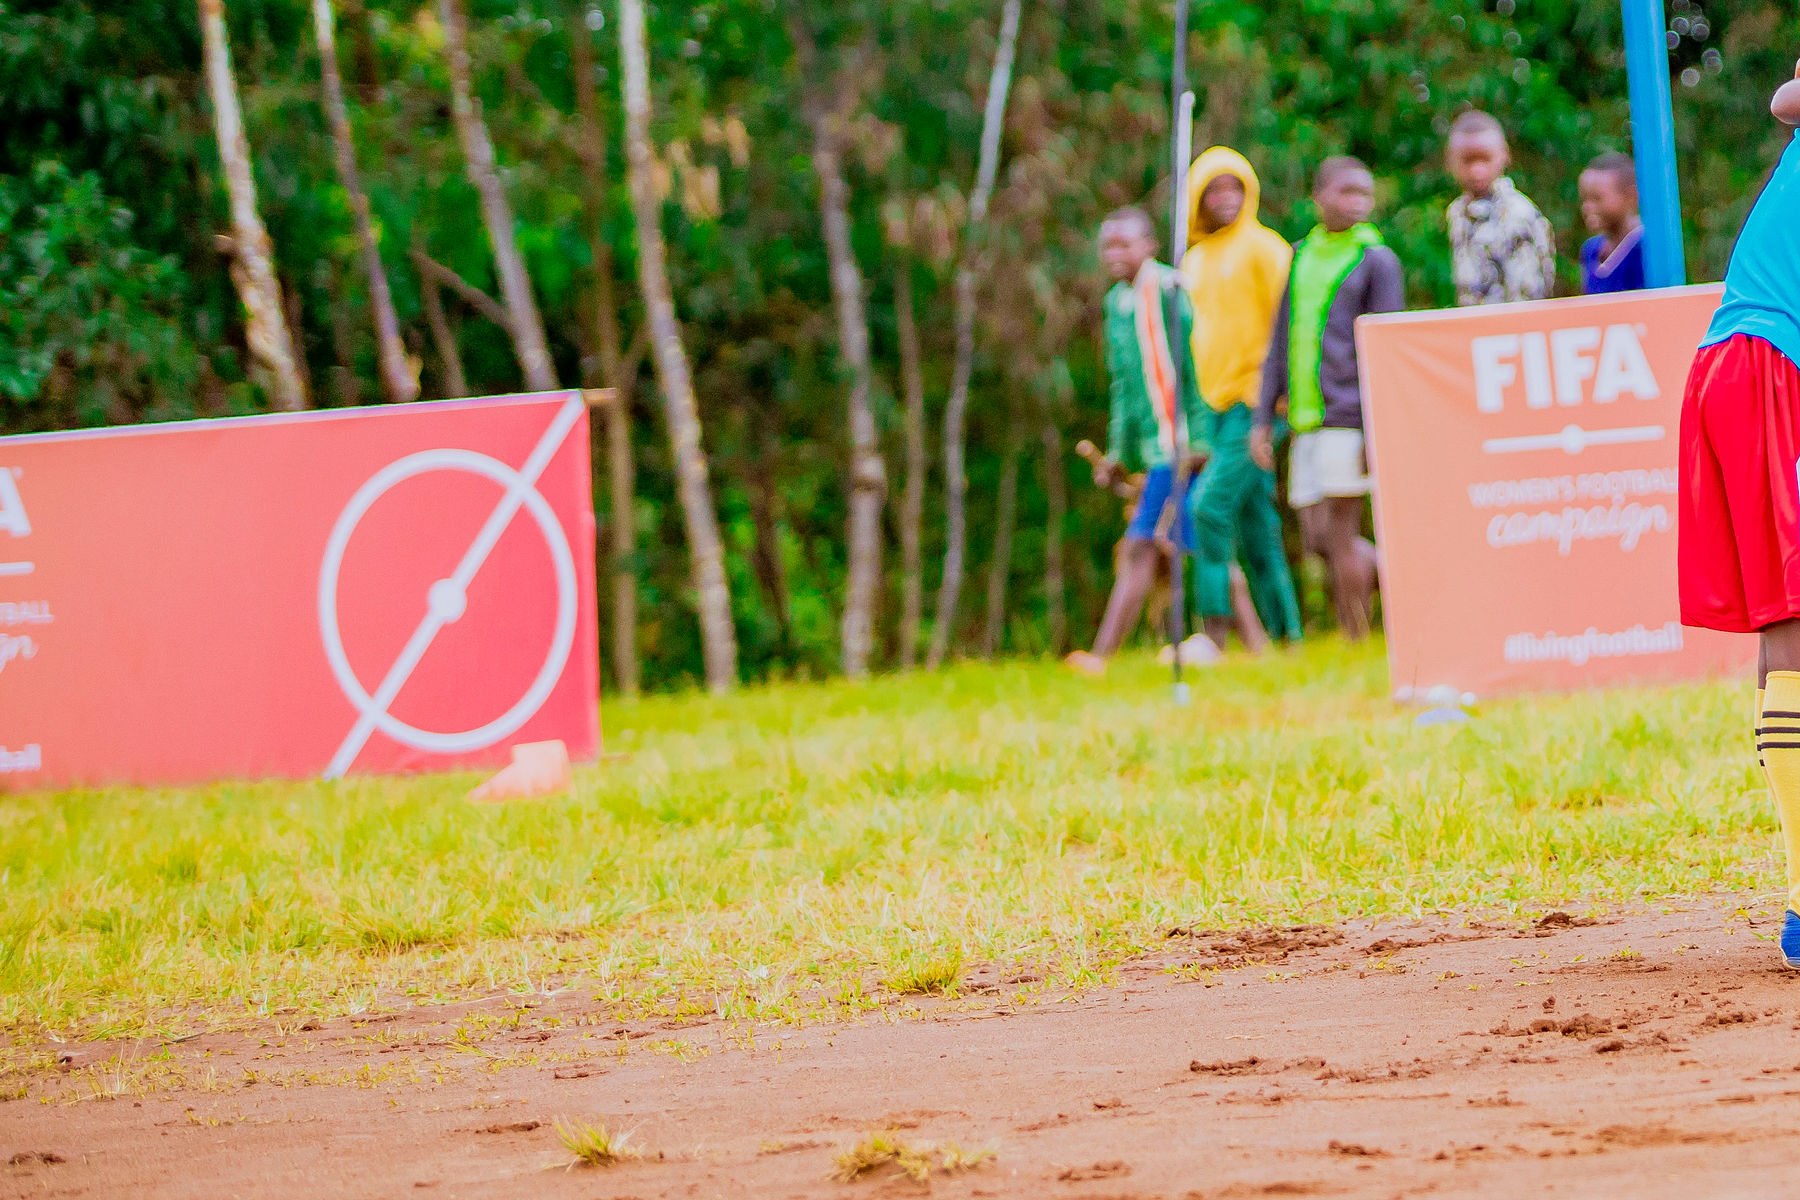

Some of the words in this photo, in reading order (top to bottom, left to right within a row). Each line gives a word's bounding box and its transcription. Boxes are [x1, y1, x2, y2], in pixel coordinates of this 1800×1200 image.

[1471, 324, 1661, 413] FIFA
[1469, 477, 1574, 506] WOMEN'S
[1486, 495, 1673, 556] campaign
[1506, 623, 1682, 664] #livingfootball
